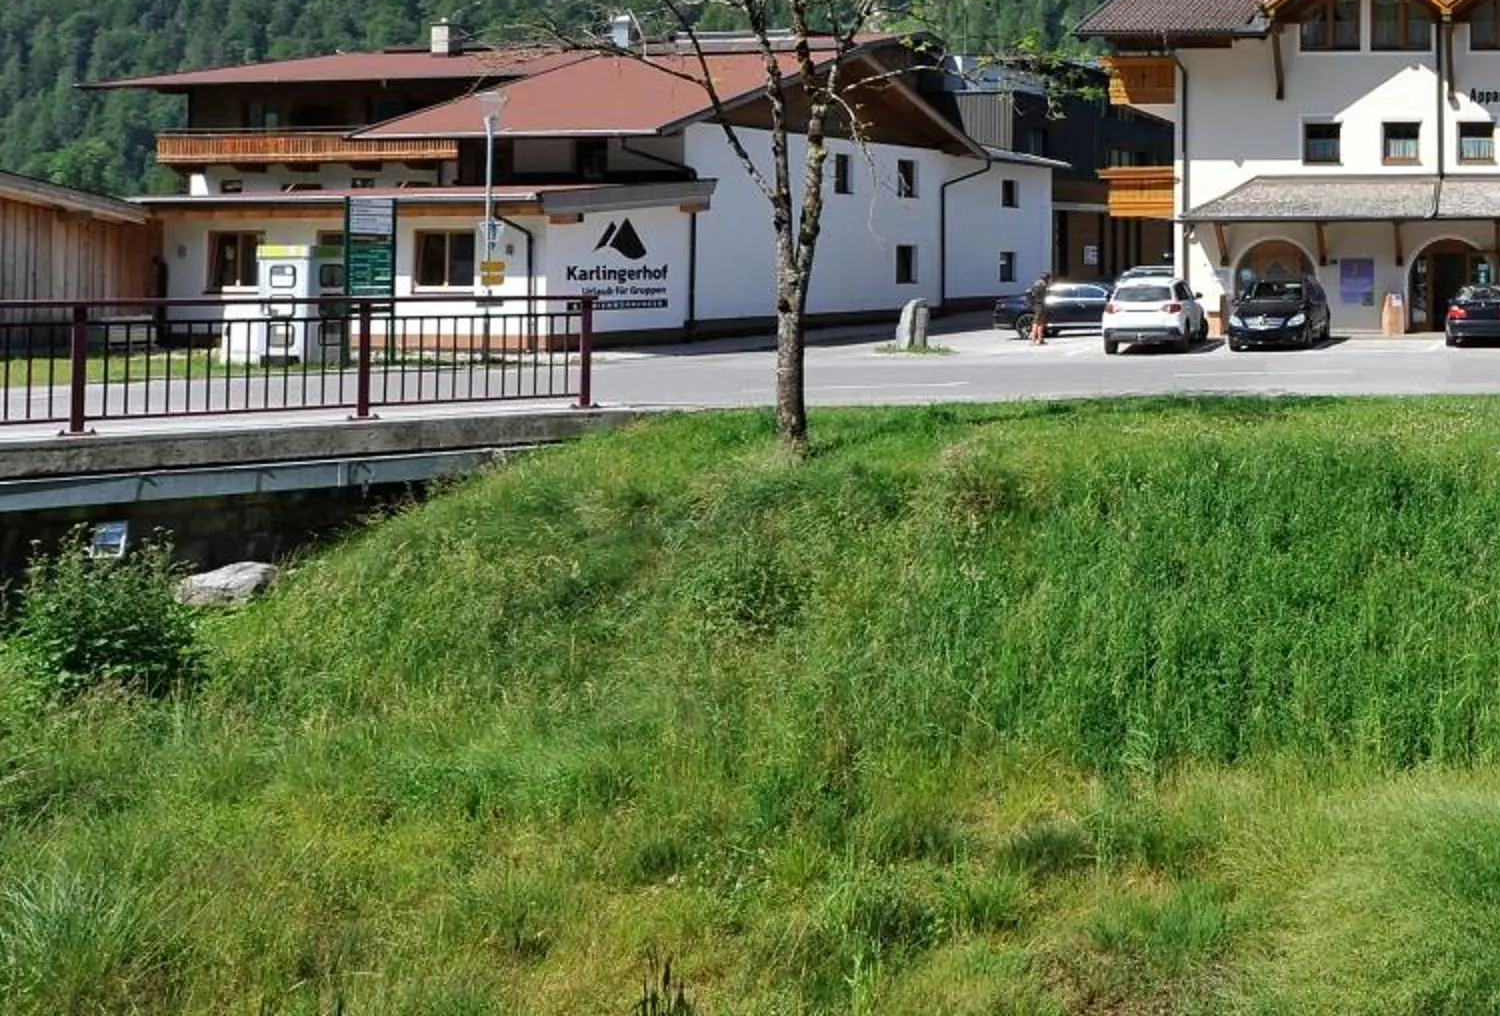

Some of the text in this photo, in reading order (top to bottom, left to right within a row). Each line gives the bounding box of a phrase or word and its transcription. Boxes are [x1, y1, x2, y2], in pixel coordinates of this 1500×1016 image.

[566, 264, 669, 284] Karlingerhof
[616, 286, 628, 295] für
[630, 285, 666, 296] Gruppen
